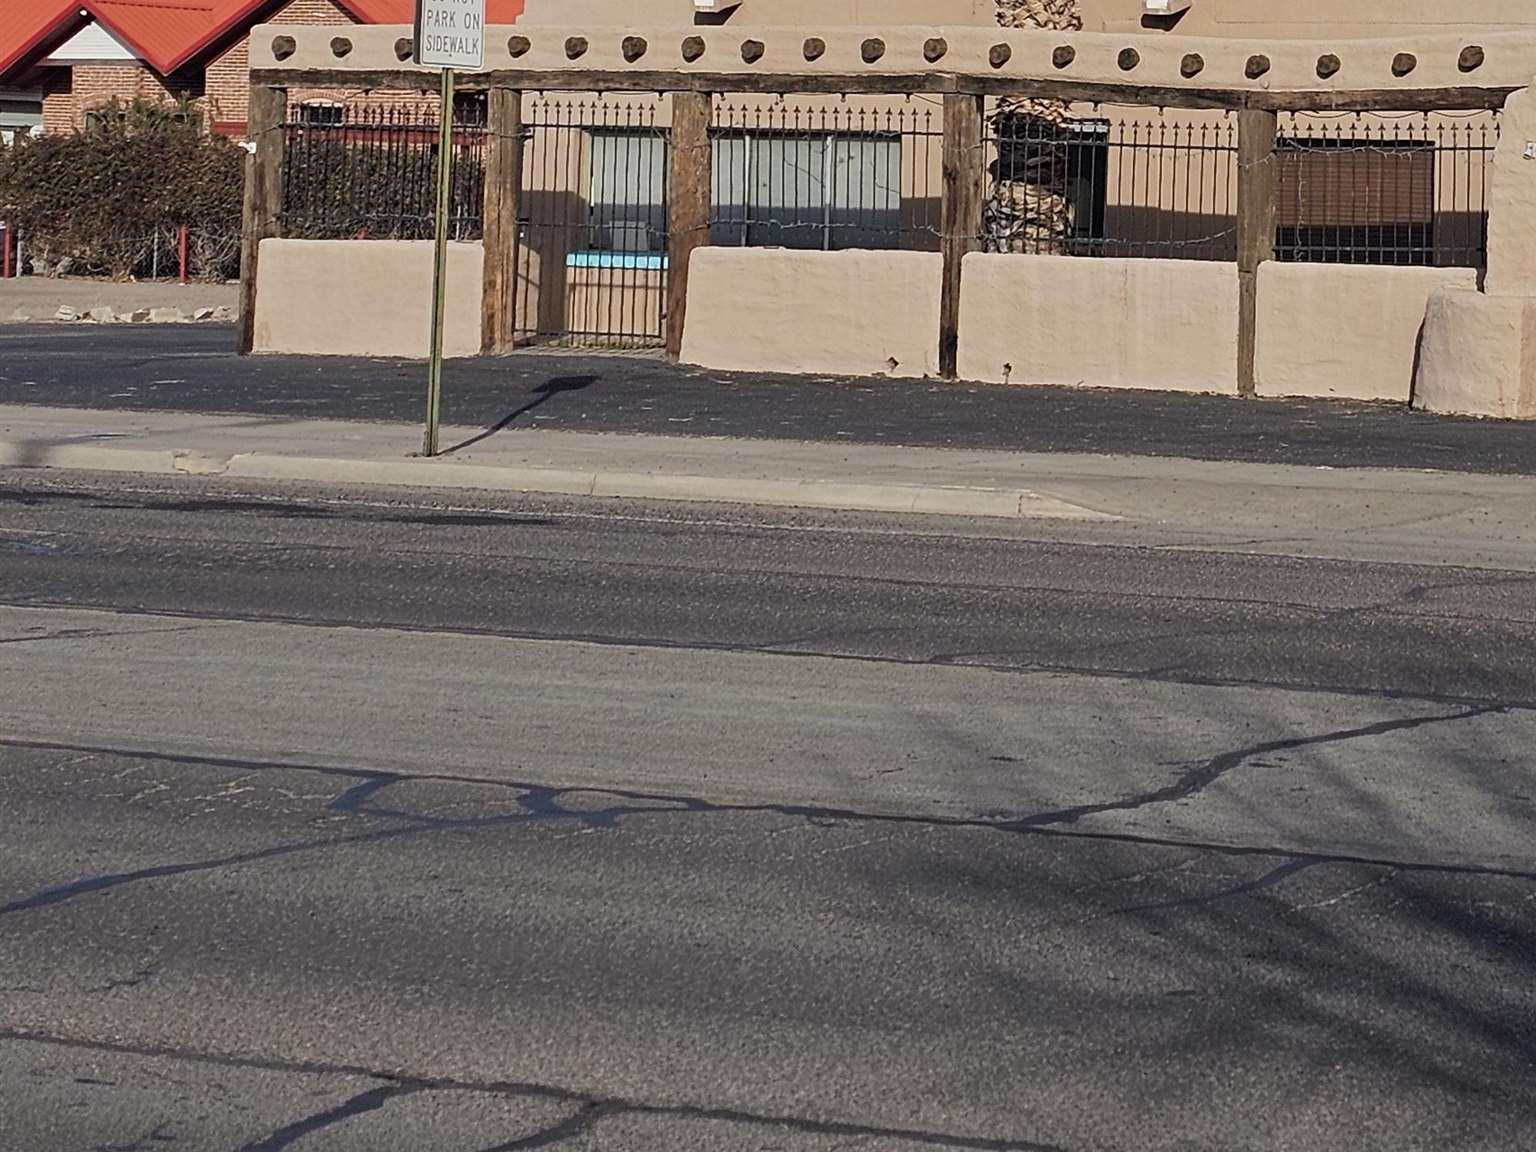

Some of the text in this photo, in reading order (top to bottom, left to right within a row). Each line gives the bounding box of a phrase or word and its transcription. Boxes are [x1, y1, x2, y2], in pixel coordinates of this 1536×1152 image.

[426, 9, 480, 30] PARK ON
[425, 35, 479, 55] SIDEWALK
